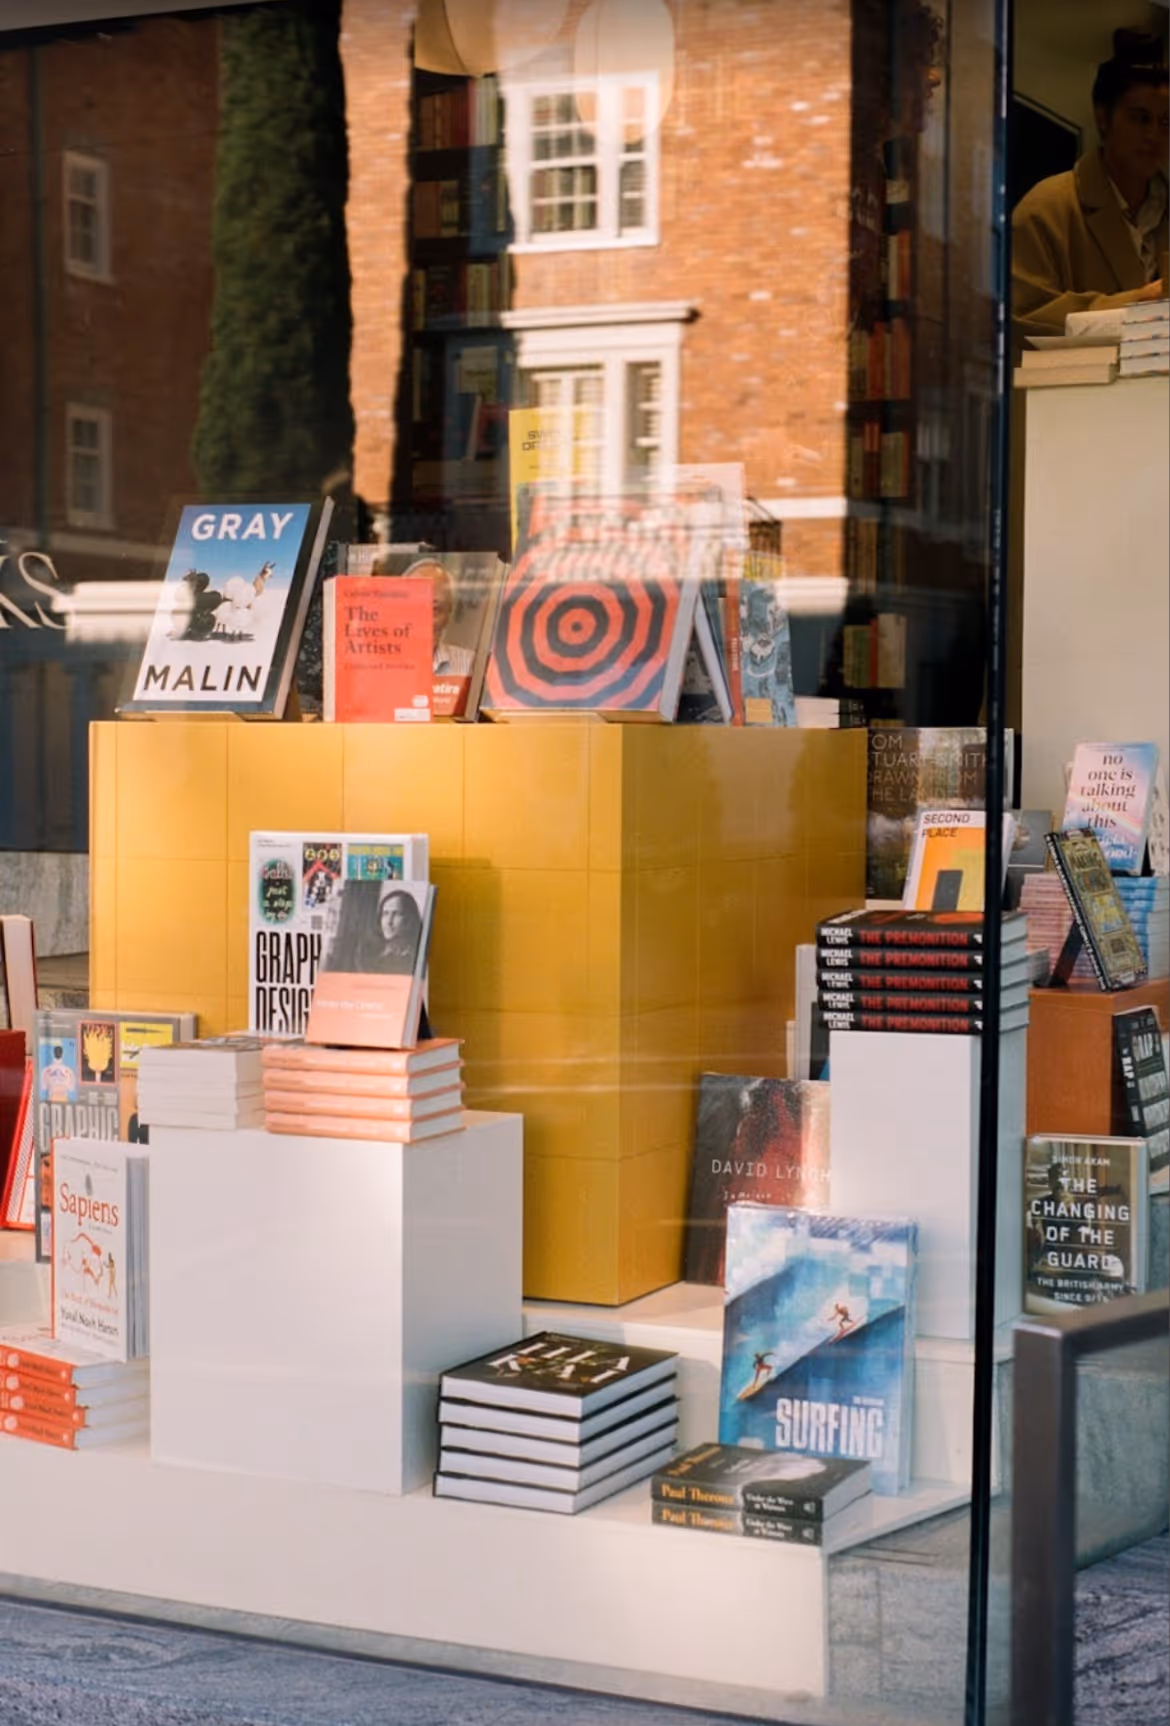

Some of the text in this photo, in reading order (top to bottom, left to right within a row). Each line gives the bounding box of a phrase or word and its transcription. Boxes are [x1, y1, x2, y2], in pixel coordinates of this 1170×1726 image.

[191, 512, 294, 541] GRAY
[343, 604, 379, 621] The
[345, 622, 413, 638] Lives of
[345, 639, 402, 655] Artists
[143, 664, 263, 692] MALIN
[871, 733, 903, 750] OM
[1102, 753, 1123, 766] no
[873, 770, 920, 785] RAWN
[1088, 768, 1133, 781] one is
[872, 786, 895, 802] HE
[1080, 783, 1136, 798] talking
[1082, 799, 1128, 813] about
[923, 812, 970, 825] SECOND
[1088, 814, 1117, 829] this
[921, 826, 958, 838] PLACE
[821, 928, 853, 937] MICHAEL
[826, 936, 849, 945] LEWIS
[860, 929, 968, 946] THE PREMONITION
[256, 931, 322, 985] GRAPH
[821, 949, 853, 958] MICHAEL
[860, 951, 969, 967] THE PREMONITION
[826, 957, 849, 967] LEWIS
[821, 972, 854, 982] MICHAEL
[859, 975, 968, 990] THE PREMONITION
[823, 992, 855, 1003] MICHAEL
[861, 996, 969, 1012] THE PREMONITION
[256, 986, 315, 1034] DESIG
[823, 1011, 855, 1022] MICHAEL
[861, 1015, 970, 1032] THE PREMONITION
[39, 1102, 119, 1153] GRAPHIC
[711, 1159, 768, 1178] DAVID
[1051, 1155, 1111, 1167] SIMON AKAM
[1058, 1177, 1097, 1194] THE
[60, 1182, 118, 1227] Sapiens
[1031, 1199, 1130, 1221] CHANGING
[1046, 1225, 1114, 1245] OF THE
[1047, 1251, 1113, 1270] GUARD
[1037, 1277, 1055, 1288] THE
[1056, 1278, 1095, 1290] BRITISH
[775, 1397, 884, 1459] SURFING
[662, 1483, 687, 1499] Paul
[662, 1507, 687, 1526] Paul
